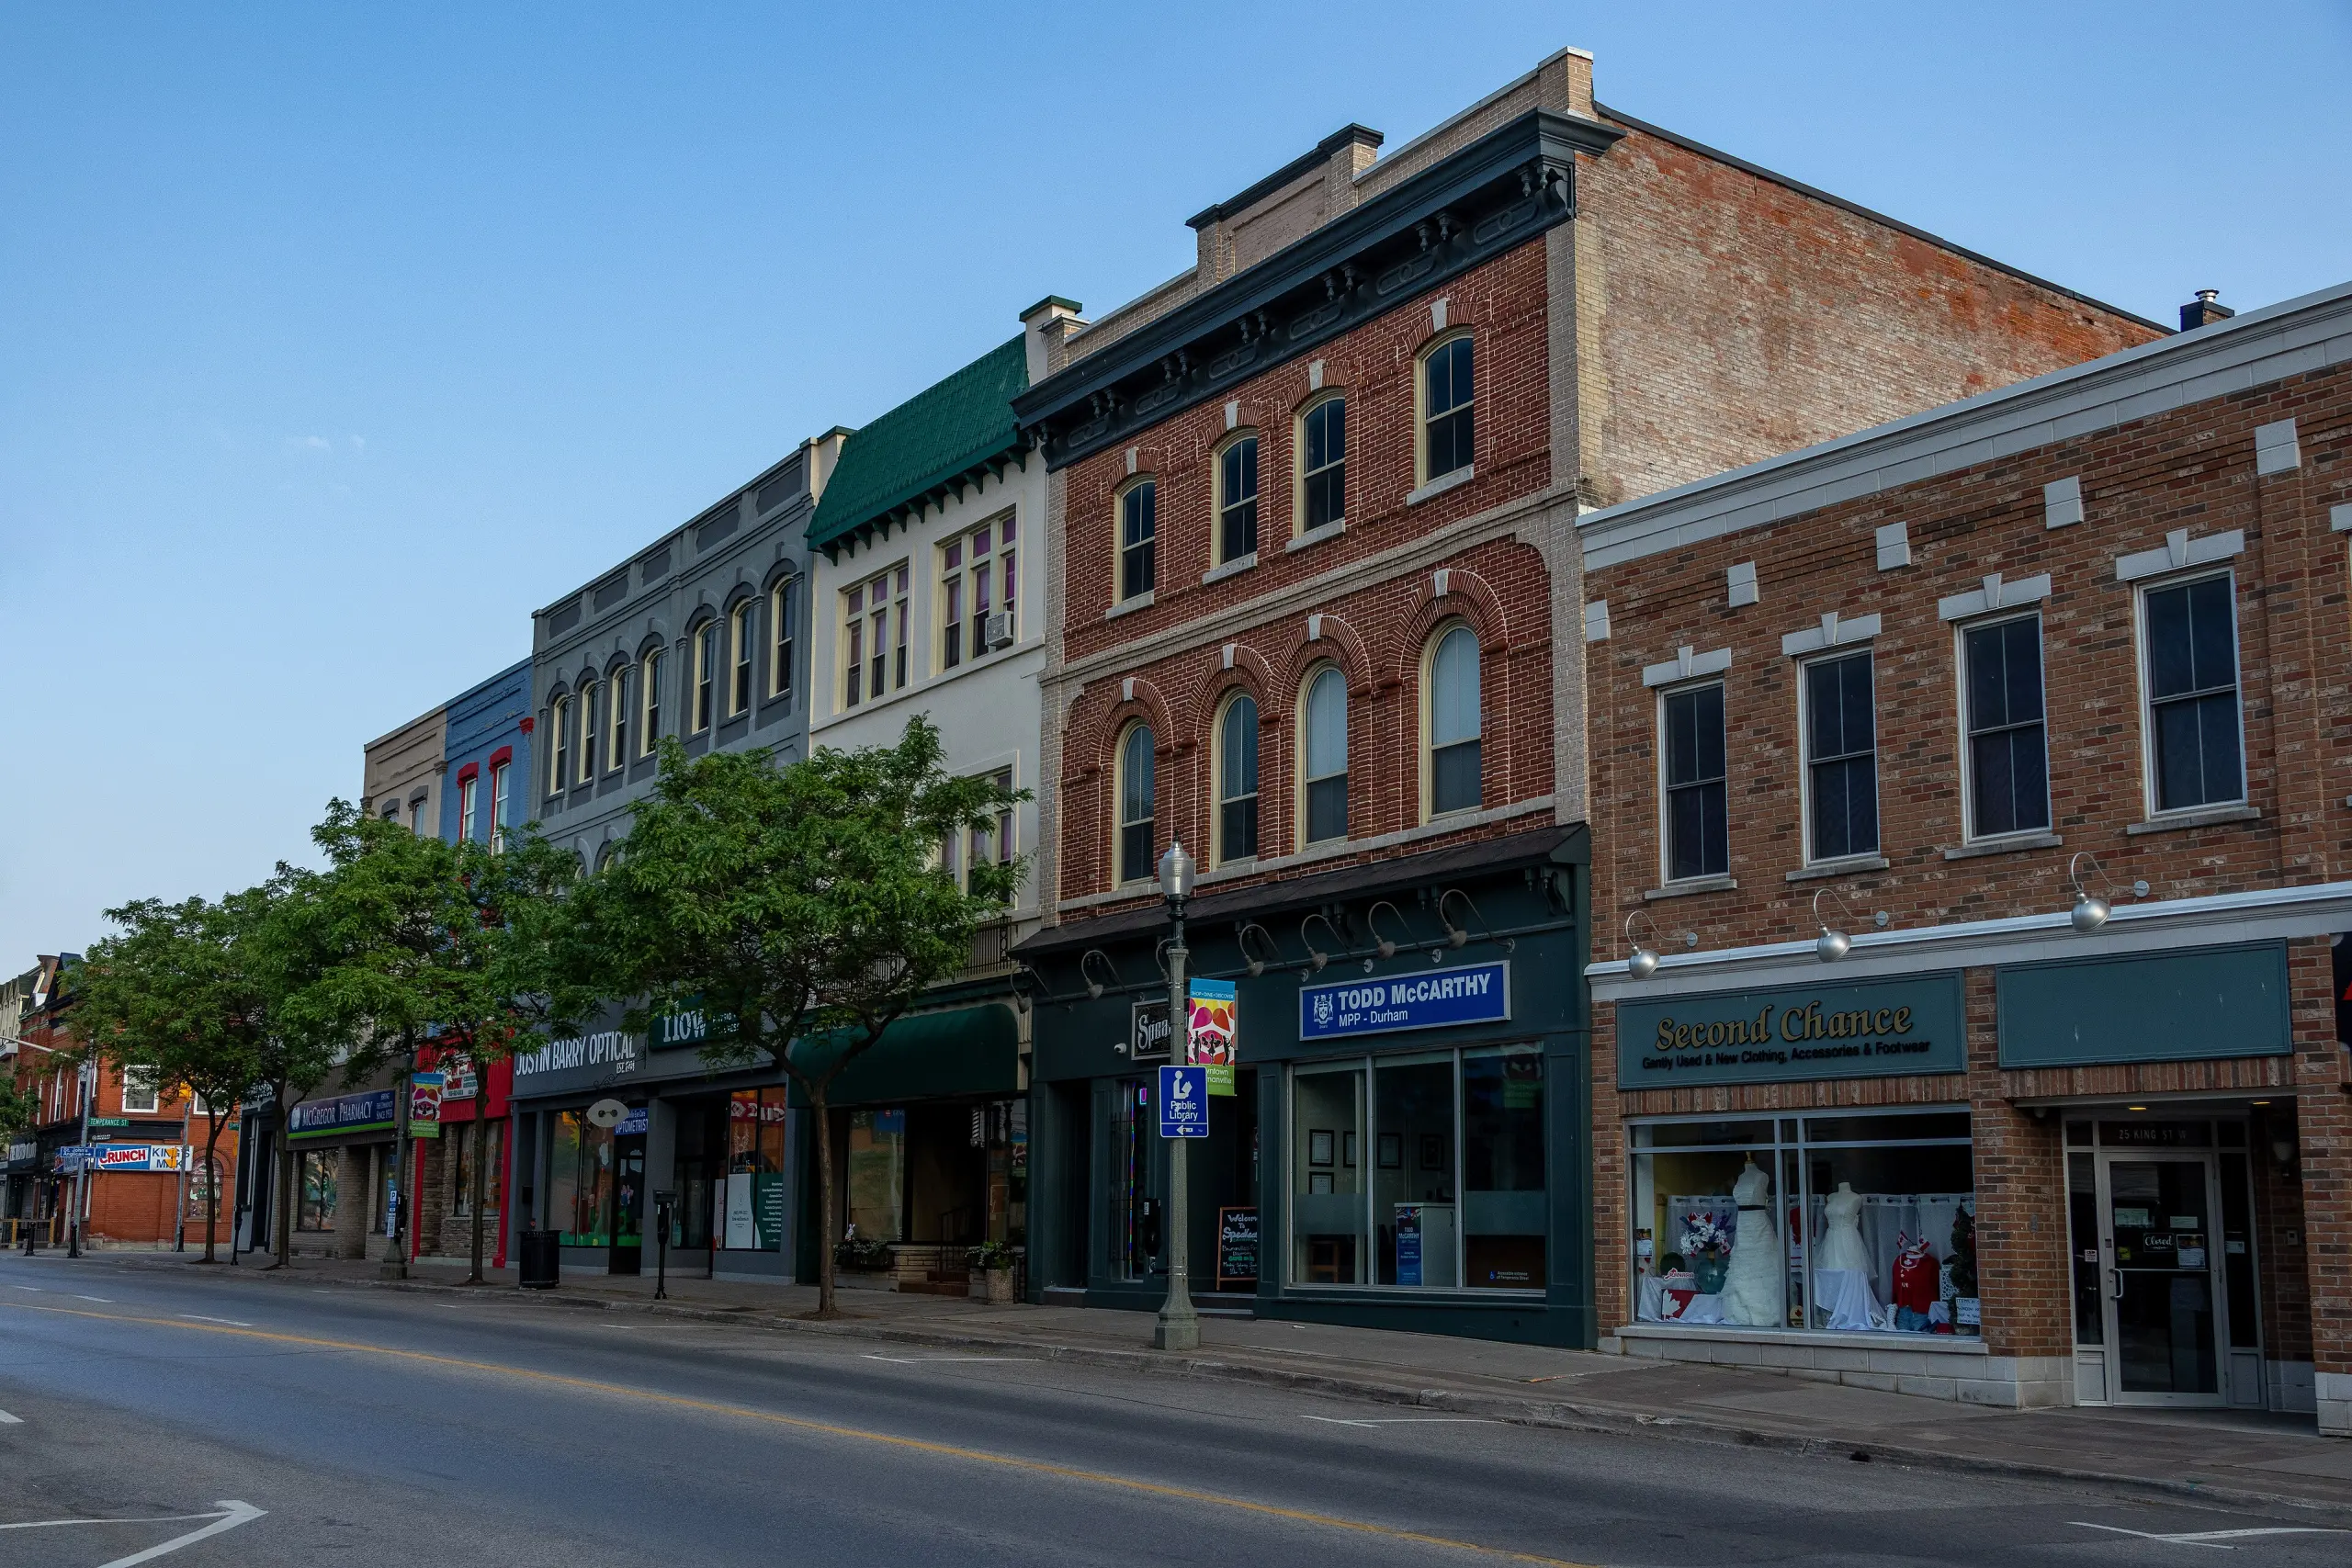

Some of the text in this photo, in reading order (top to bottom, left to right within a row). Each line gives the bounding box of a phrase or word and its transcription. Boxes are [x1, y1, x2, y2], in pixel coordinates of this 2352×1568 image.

[1338, 973, 1491, 1011] TODD McCARTHY
[1339, 1012, 1361, 1027] MPP
[1370, 1009, 1408, 1023] Durham
[1655, 999, 1913, 1052] Second Chance
[515, 1043, 550, 1077] JUSTIN
[552, 1036, 587, 1070] BARRY
[588, 1029, 636, 1066] OPTICAL
[1643, 1040, 1930, 1070] Gently Used & New Clothing, Accessories & Footwear
[1170, 1100, 1197, 1110] Public
[1169, 1110, 1199, 1121] Library
[2119, 1129, 2187, 1141] 25 KING ST W
[1227, 1213, 1257, 1223] Welcom
[2145, 1235, 2173, 1246] Closed
